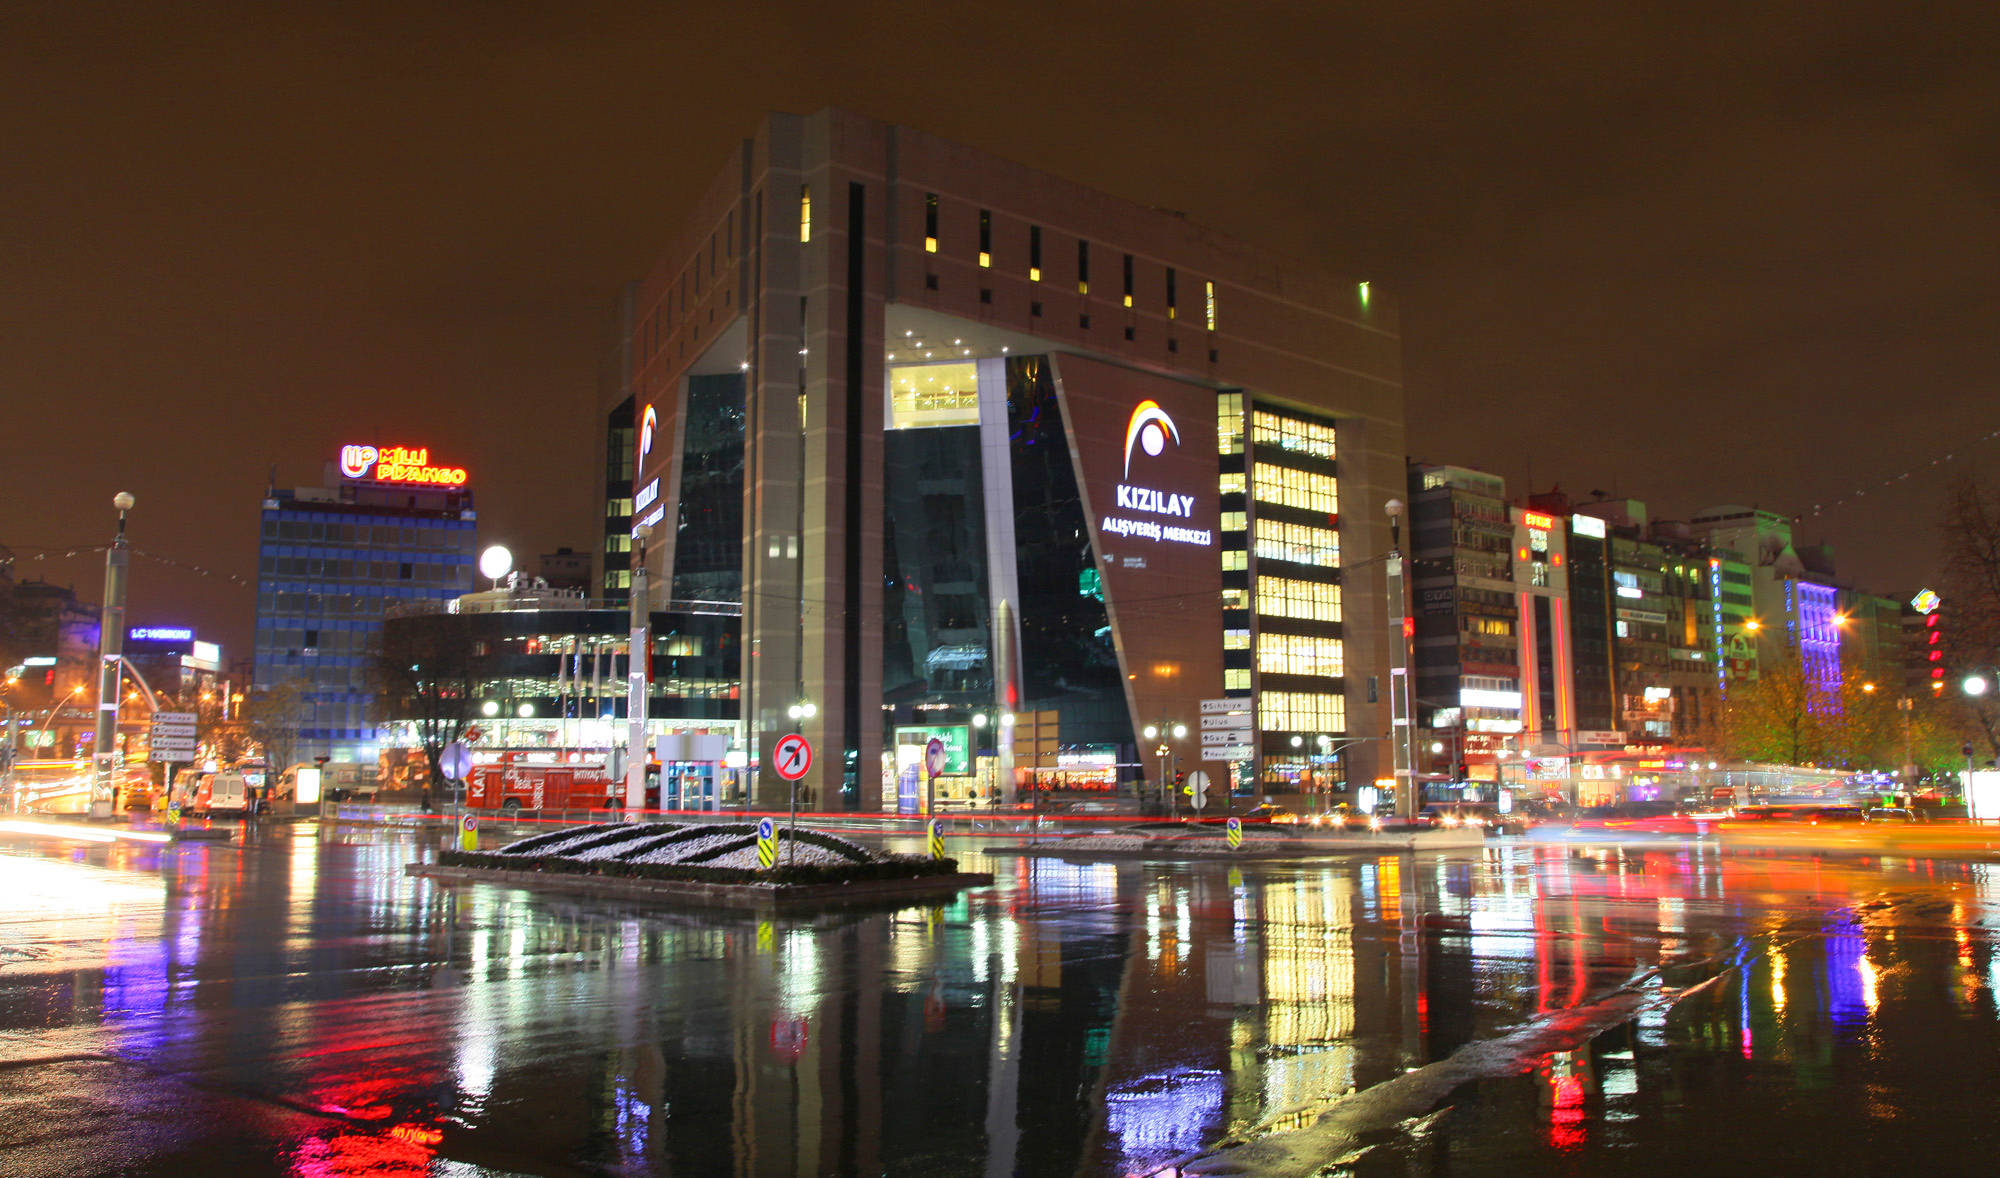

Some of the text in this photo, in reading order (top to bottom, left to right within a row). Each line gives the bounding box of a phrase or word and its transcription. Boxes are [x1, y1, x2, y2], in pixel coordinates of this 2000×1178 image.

[378, 447, 428, 468] MİLLİ
[376, 464, 467, 485] PİYANGO
[1117, 484, 1194, 518] KIZILAY
[1102, 516, 1211, 546] ALIŞVERİŞ MERKEZİ
[472, 766, 487, 798] KAN
